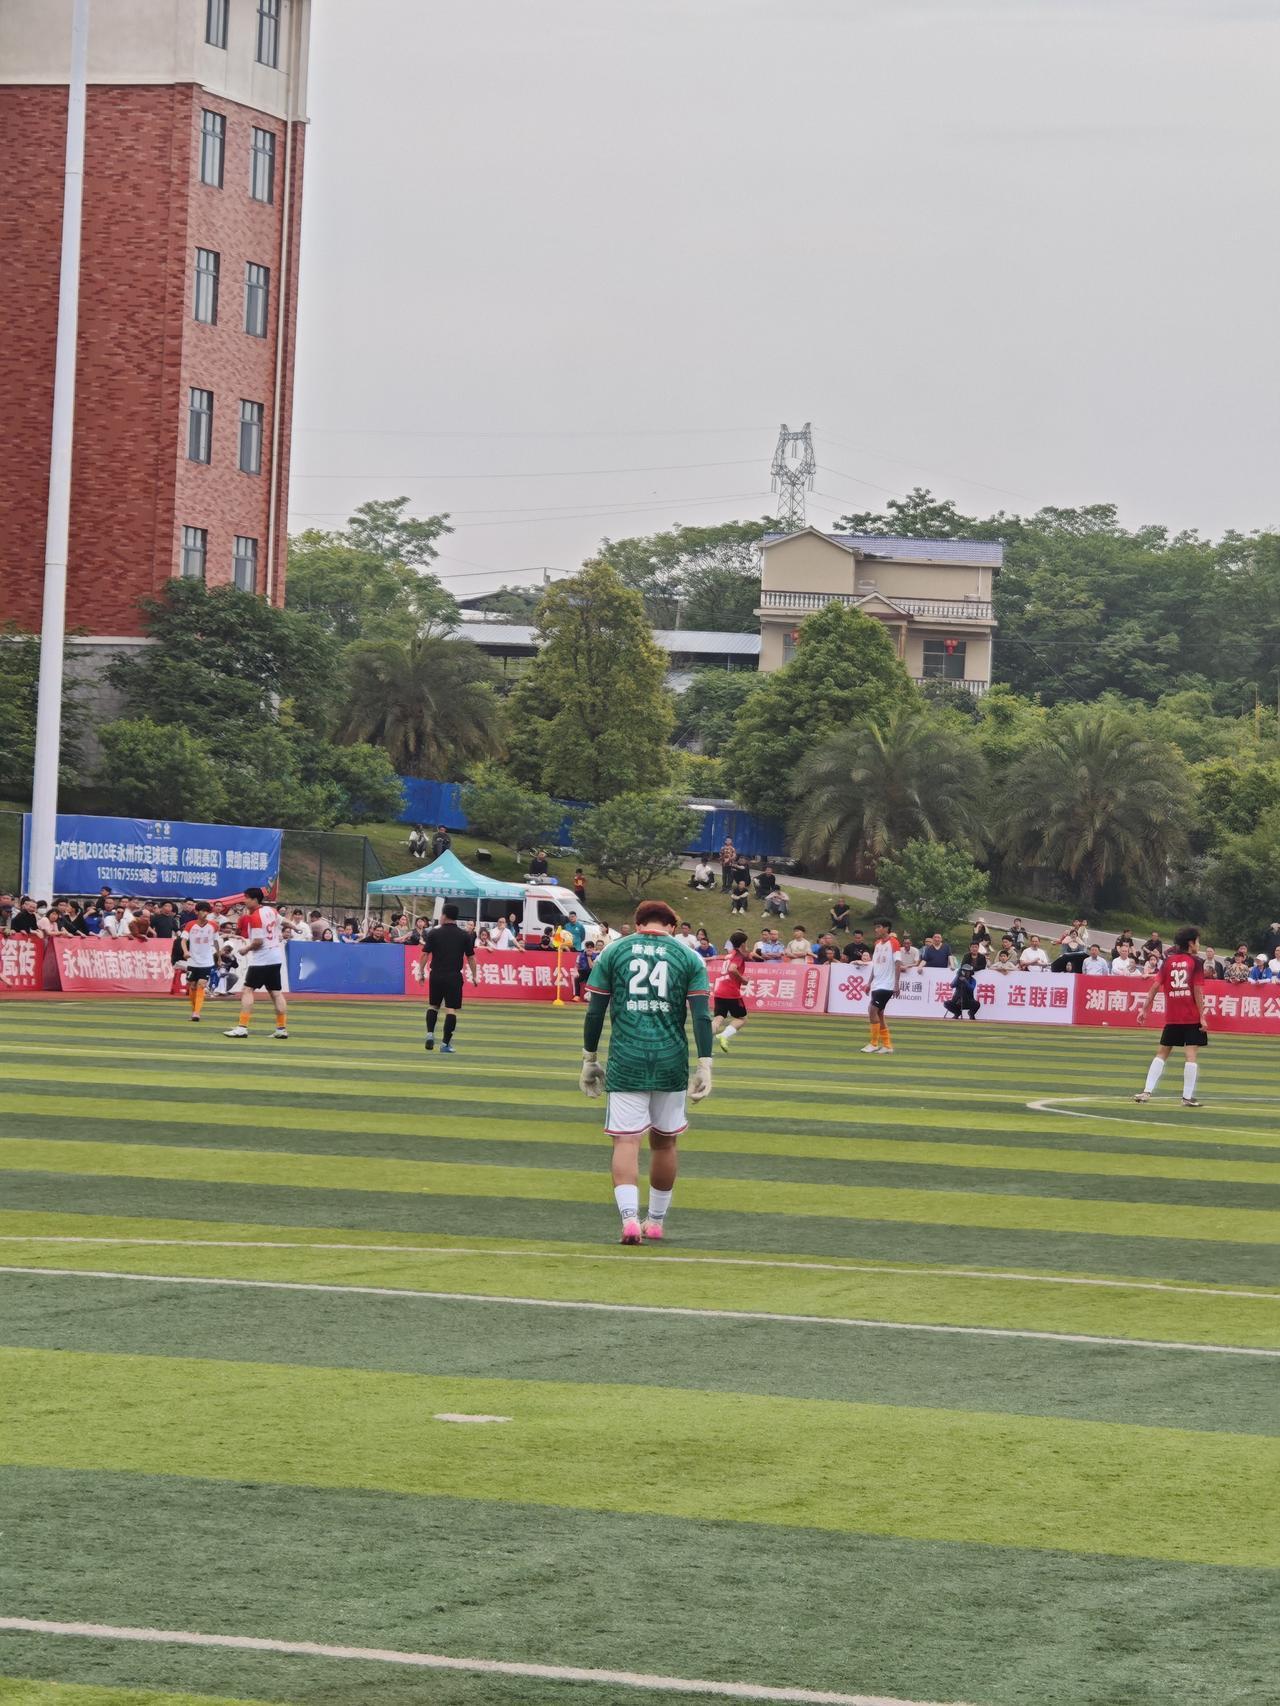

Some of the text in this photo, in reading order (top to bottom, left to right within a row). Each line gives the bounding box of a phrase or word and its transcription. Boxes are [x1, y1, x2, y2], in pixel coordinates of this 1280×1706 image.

[1, 938, 35, 977] 瓷砖
[629, 958, 668, 997] 24
[1170, 969, 1188, 988] 32
[626, 1000, 671, 1012] 向阳学校
[935, 981, 1068, 1008] 装带 选联通
